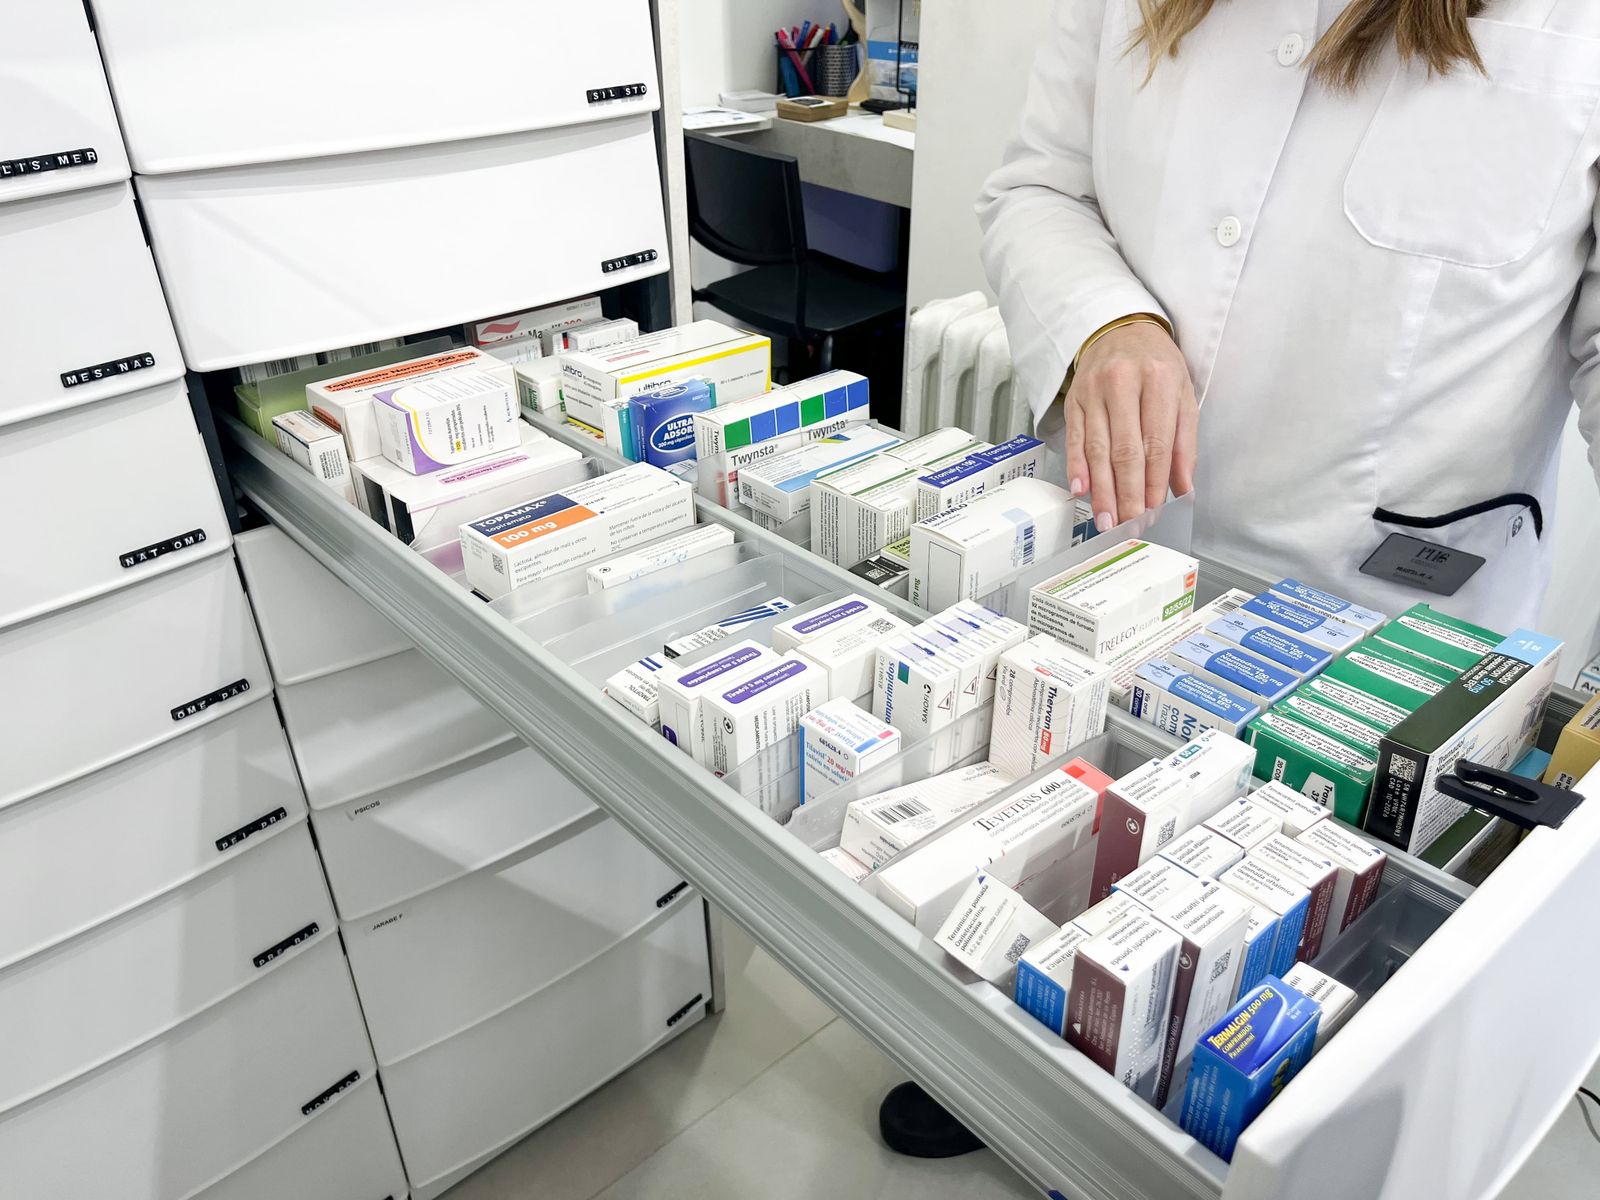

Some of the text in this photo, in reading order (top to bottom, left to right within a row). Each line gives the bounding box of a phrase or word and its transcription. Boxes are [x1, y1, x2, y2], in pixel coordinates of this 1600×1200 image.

[592, 89, 616, 101] SIL
[56, 151, 98, 168] MER
[606, 258, 629, 272] SUL
[65, 356, 155, 386] MES NAS
[485, 514, 532, 533] topiramato
[920, 503, 968, 525] TRITAMLO
[500, 520, 558, 543] 100 mg
[124, 533, 207, 568] NAT OMA
[1031, 594, 1044, 605] Cada
[1030, 608, 1037, 616] de
[1038, 603, 1069, 622] microgramos
[1069, 617, 1076, 625] de
[1076, 620, 1095, 633] furoato
[1037, 617, 1075, 639] microgramos de
[1099, 623, 1138, 654] TRELEGY
[1303, 653, 1318, 662] mg
[1488, 658, 1518, 678] Normon
[1253, 670, 1270, 682] 100
[1269, 676, 1285, 687] mg
[1480, 677, 1495, 687] 50
[1497, 662, 1530, 686] Tramadol
[176, 682, 250, 720] OME PAU
[1006, 668, 1016, 716] 28 comprimidos
[1216, 693, 1233, 705] 100
[1232, 701, 1248, 712] mg
[921, 693, 931, 724] SANOFI
[1044, 686, 1057, 730] Thervan
[1341, 746, 1374, 766] NORMON
[1343, 757, 1357, 767] EFG
[1040, 781, 1061, 796] 600
[1387, 776, 1396, 789] CAD
[1321, 825, 1374, 857] Terramicina pomada
[1272, 838, 1324, 870] Terramicina pomada
[1241, 864, 1295, 897] pomada oftálmica
[1247, 860, 1281, 882] Terramicina
[947, 884, 989, 942] Terramicina pomada
[1170, 885, 1220, 922] Terracortril pomada
[960, 920, 983, 952] polimixina
[1110, 927, 1163, 966] Terracortril pomada
[1207, 988, 1274, 1050] TERMALGIN 500 mg
[1221, 1024, 1253, 1054] COMPRIMIDOS
[1228, 1033, 1256, 1060] Paracetamol
